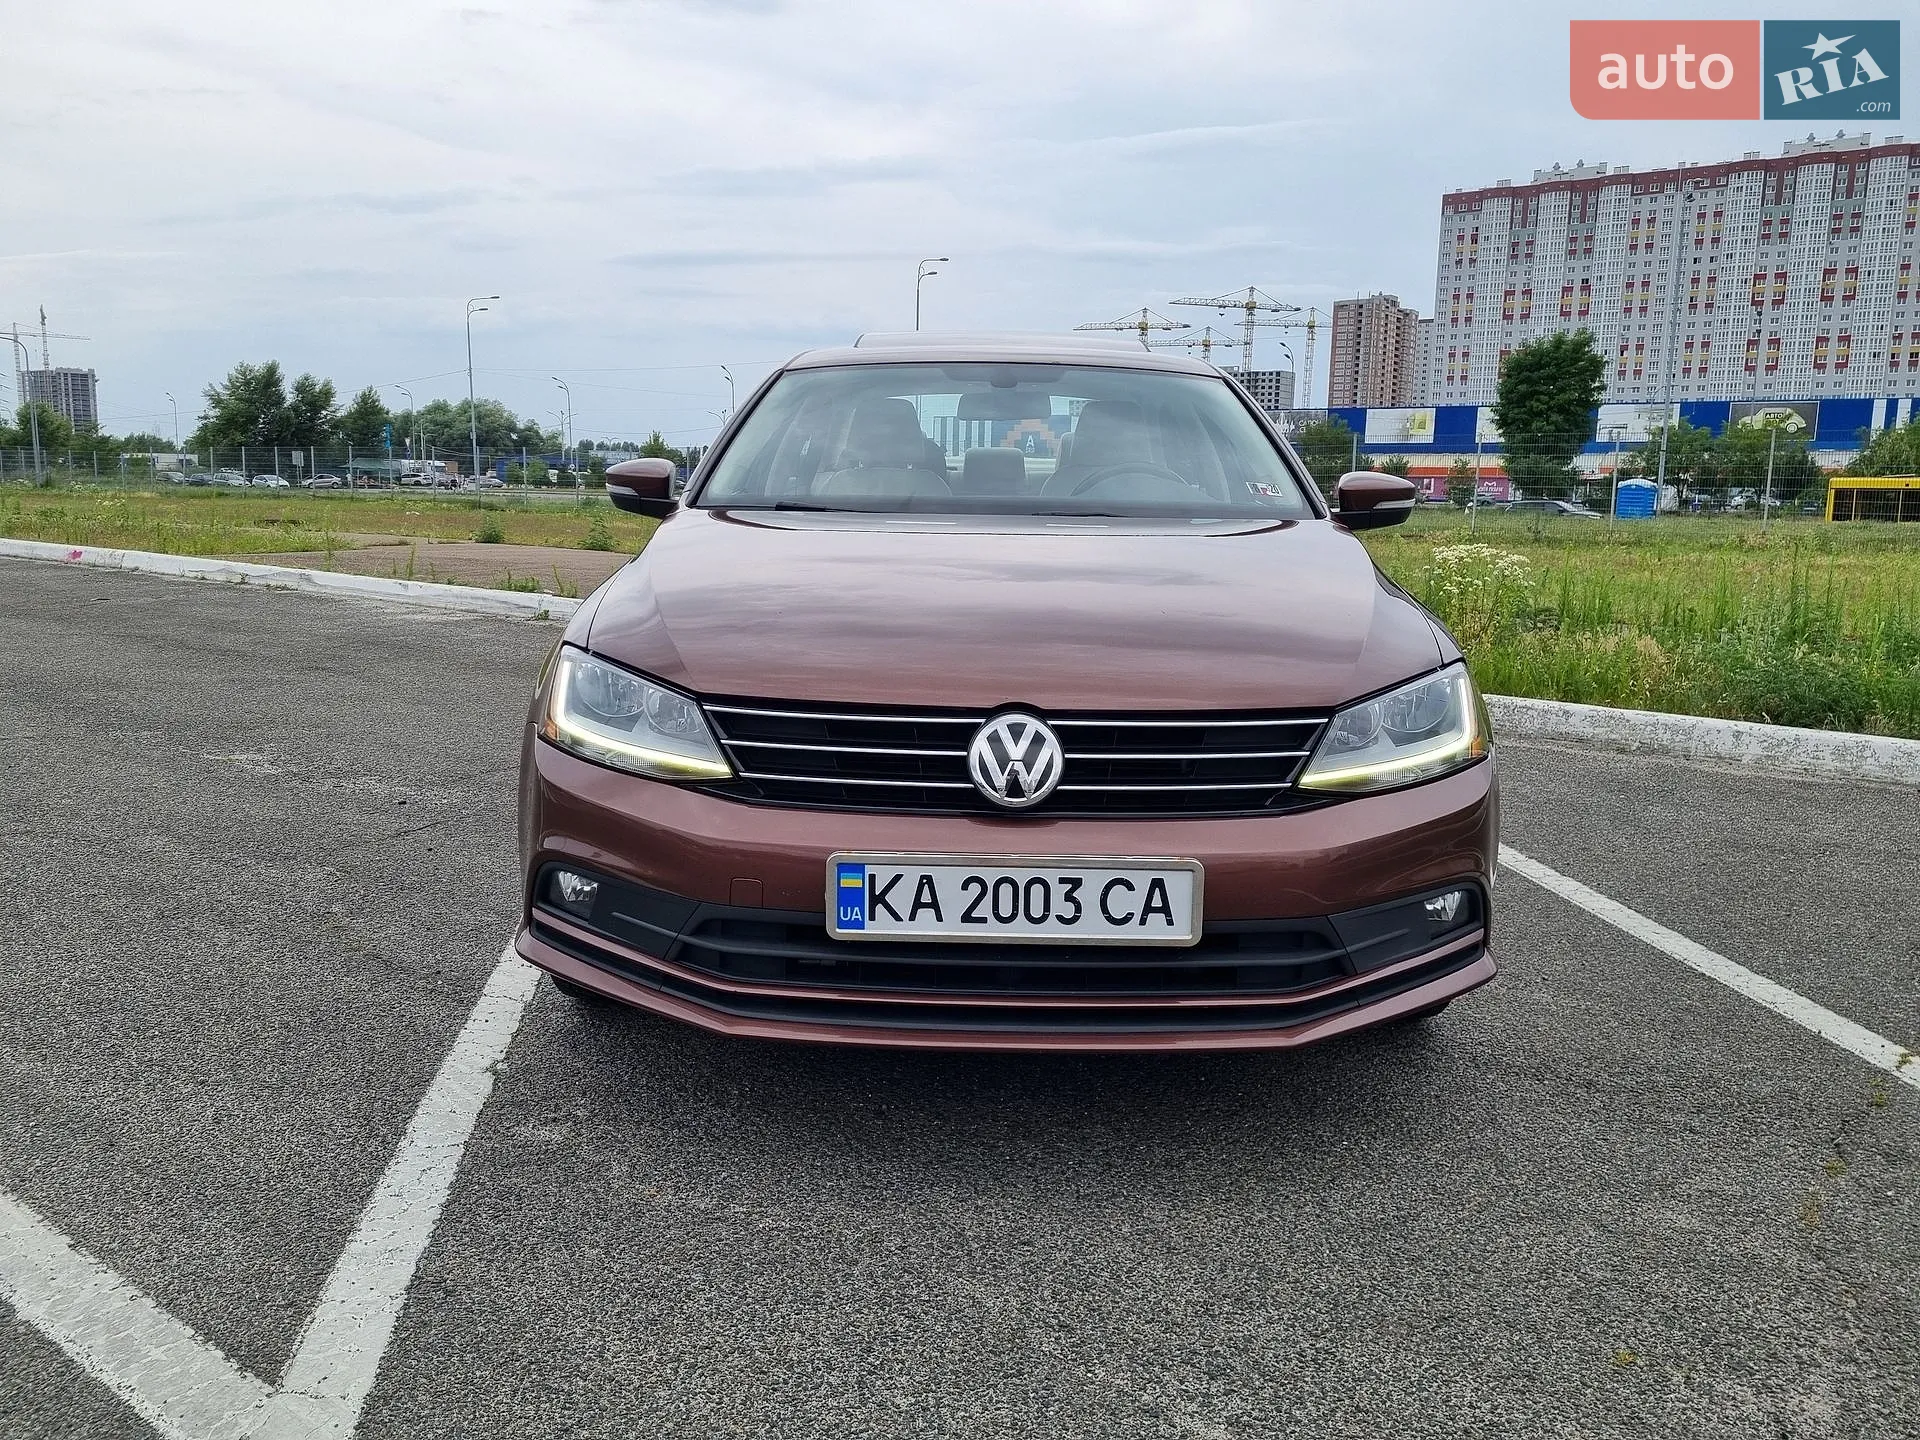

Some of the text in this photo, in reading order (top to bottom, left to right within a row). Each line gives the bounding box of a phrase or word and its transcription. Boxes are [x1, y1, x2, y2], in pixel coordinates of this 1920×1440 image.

[839, 906, 863, 922] UA
[867, 873, 1175, 927] KA 2003 CA
